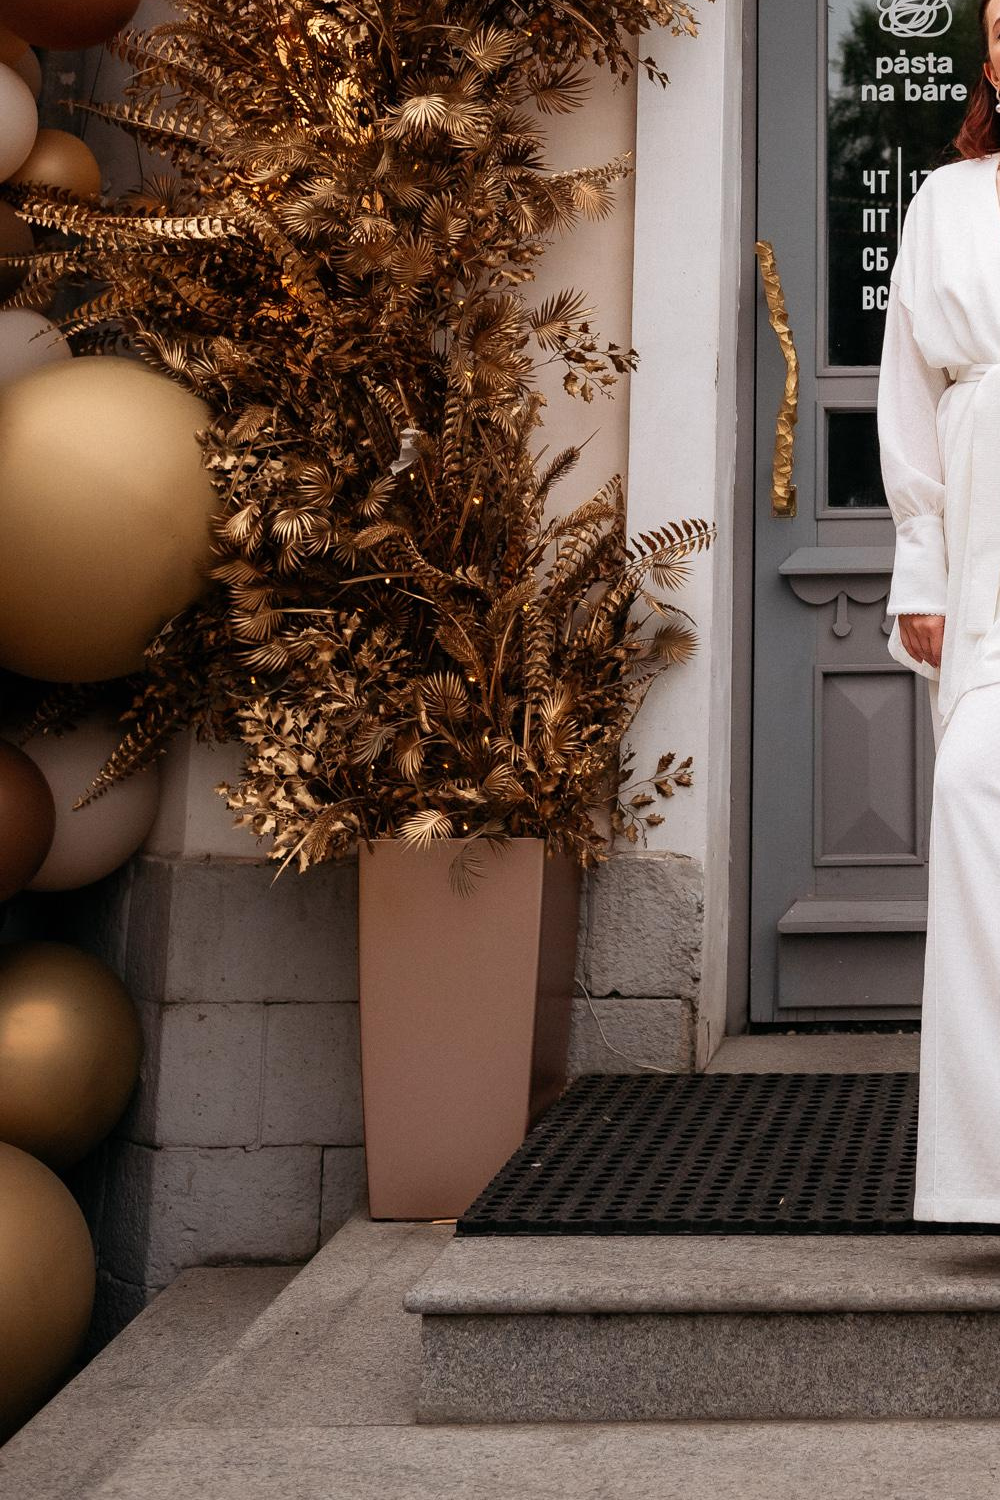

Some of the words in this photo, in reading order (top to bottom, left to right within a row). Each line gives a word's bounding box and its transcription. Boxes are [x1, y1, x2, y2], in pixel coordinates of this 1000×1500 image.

[861, 84, 895, 101] na
[862, 170, 890, 194] ЧТ
[862, 208, 890, 233] ПТ
[862, 247, 889, 272] СБ
[862, 285, 889, 311] ВС
